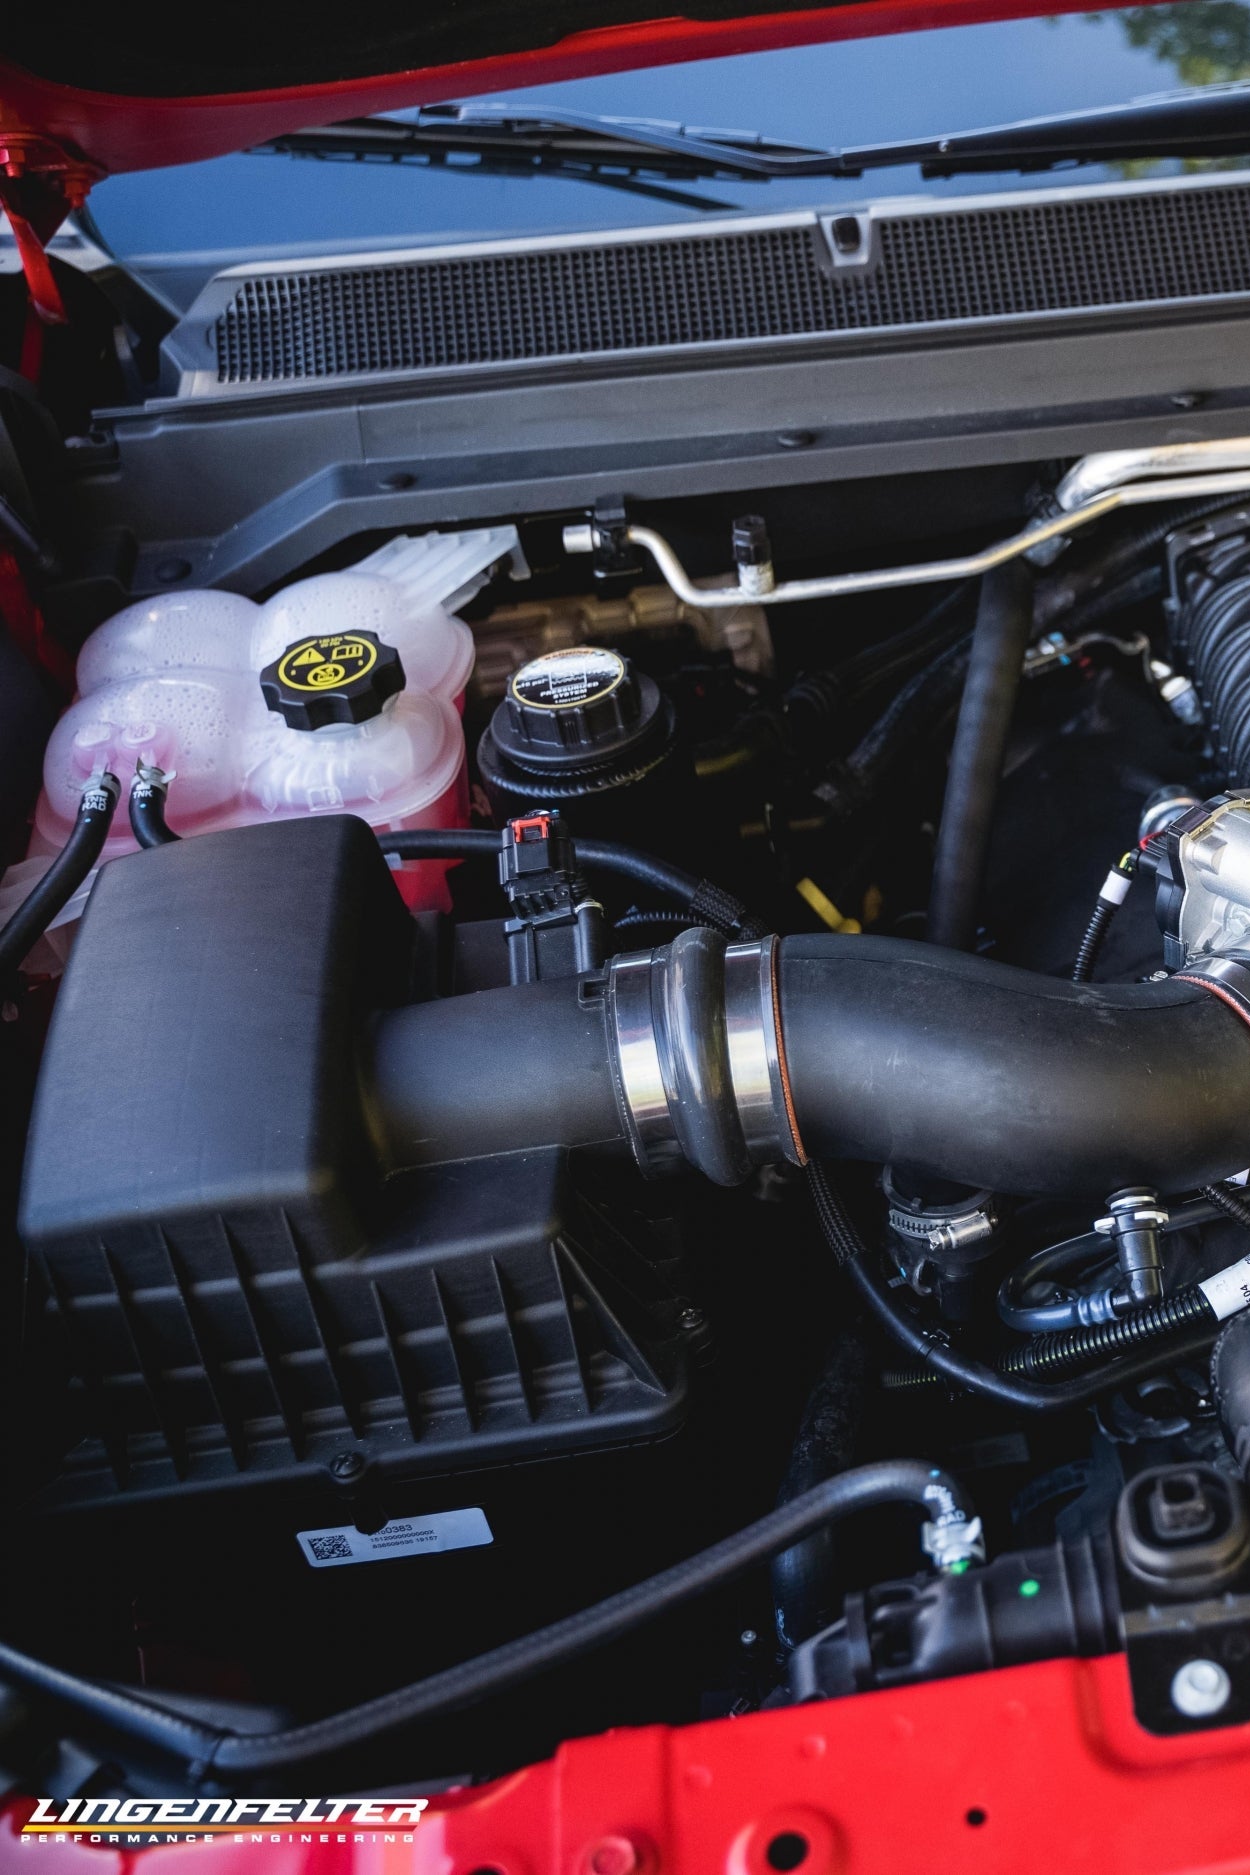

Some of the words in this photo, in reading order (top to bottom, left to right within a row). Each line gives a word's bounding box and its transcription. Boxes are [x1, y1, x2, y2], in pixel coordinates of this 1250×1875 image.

[552, 688, 588, 699] SYSTEM
[133, 790, 153, 799] TNK
[82, 801, 107, 812] RAD
